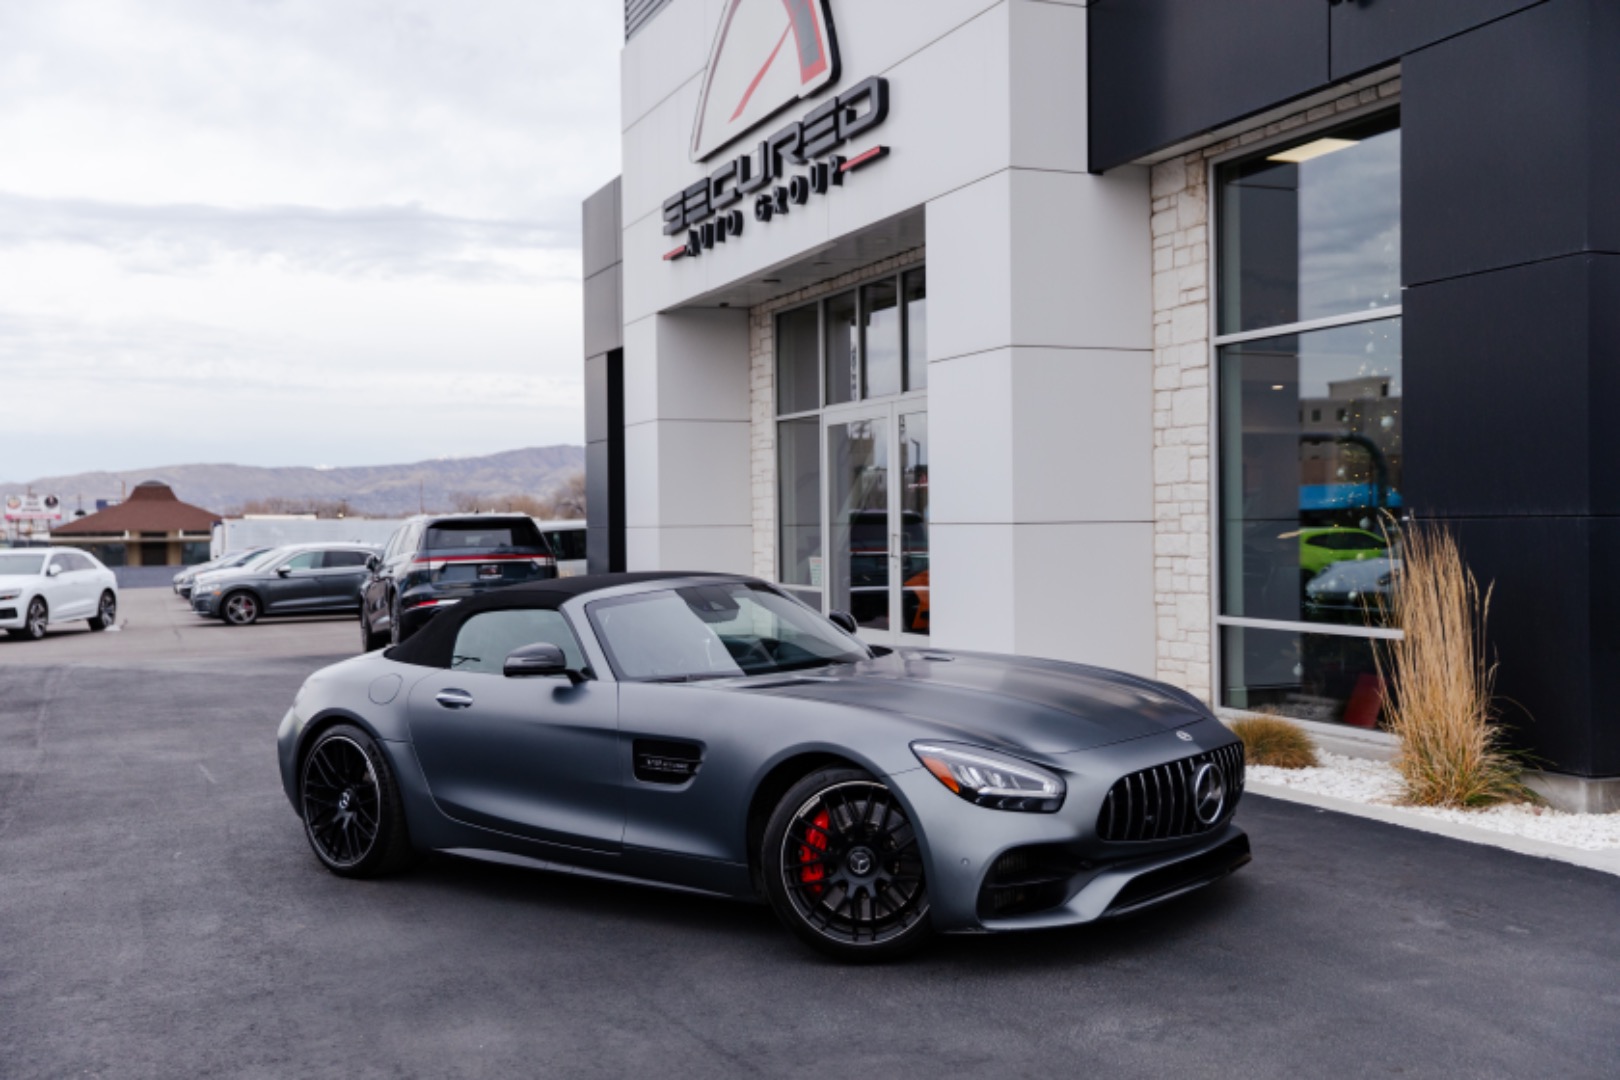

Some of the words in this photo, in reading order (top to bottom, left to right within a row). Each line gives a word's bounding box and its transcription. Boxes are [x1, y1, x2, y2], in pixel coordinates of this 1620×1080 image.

[663, 75, 889, 235] SECURED
[685, 210, 743, 257] AUTO
[755, 155, 846, 222] GROUP
